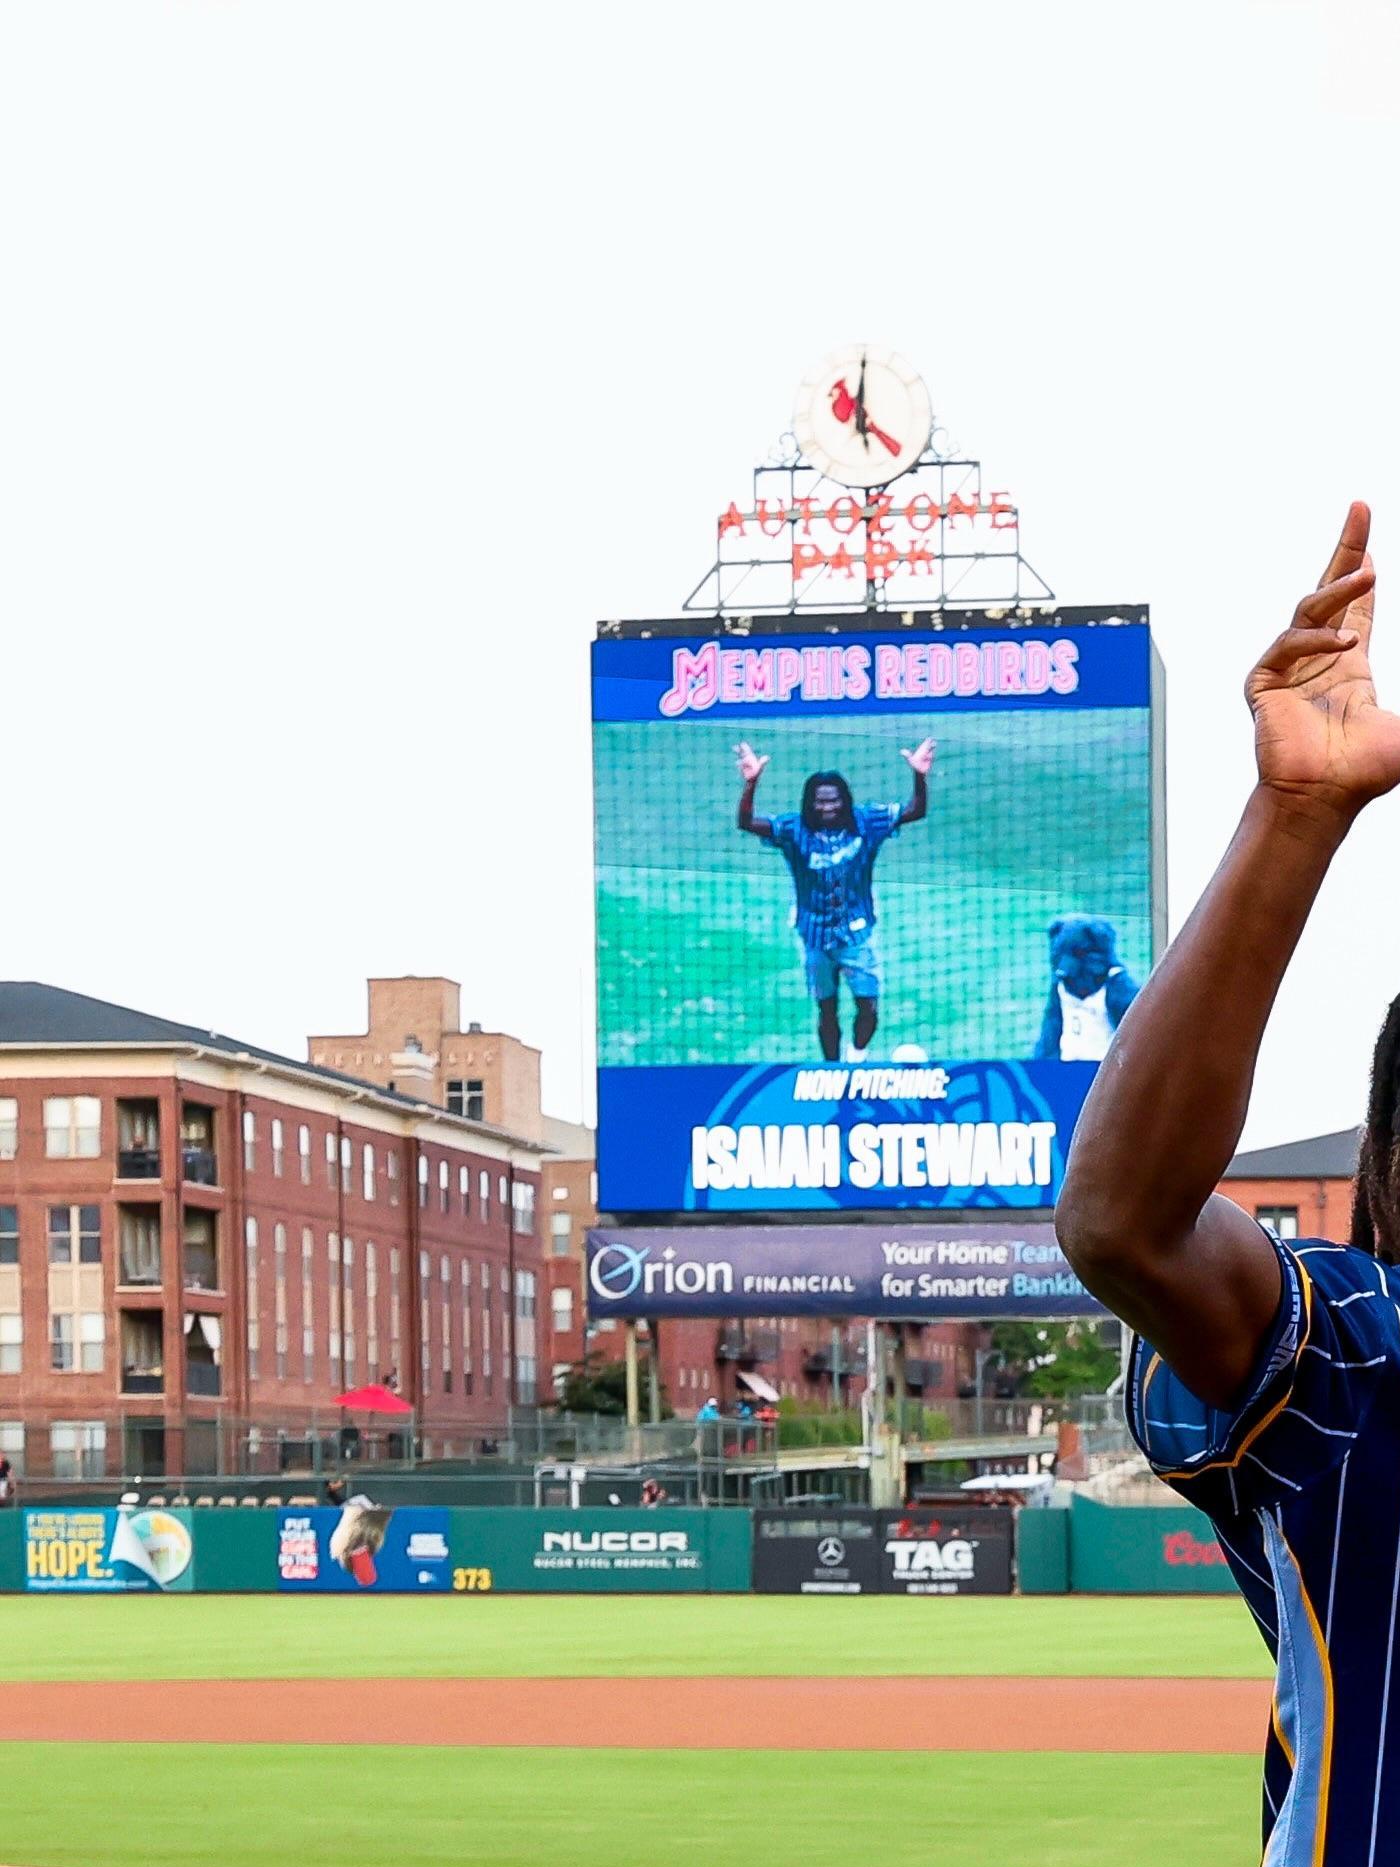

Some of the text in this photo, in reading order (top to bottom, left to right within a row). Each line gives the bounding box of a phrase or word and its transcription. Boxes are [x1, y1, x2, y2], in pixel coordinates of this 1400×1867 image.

[718, 492, 1018, 542] AUTOZONE
[792, 539, 935, 581] PARK
[660, 639, 1080, 716] MEMPHIS REDBIRDS
[793, 1068, 950, 1101] NOW PITCHING:
[692, 1122, 1056, 1189] ISAIAH STEWART
[881, 1242, 935, 1265] Your
[937, 1241, 1008, 1265] Home
[590, 1243, 856, 1300] Orion FINANCIAL
[881, 1272, 914, 1298] for
[917, 1273, 1009, 1298] Smarter
[27, 1540, 114, 1577] HOPE.
[543, 1531, 688, 1551] NUCOR
[884, 1540, 974, 1571] TAG
[453, 1567, 492, 1591] 373
